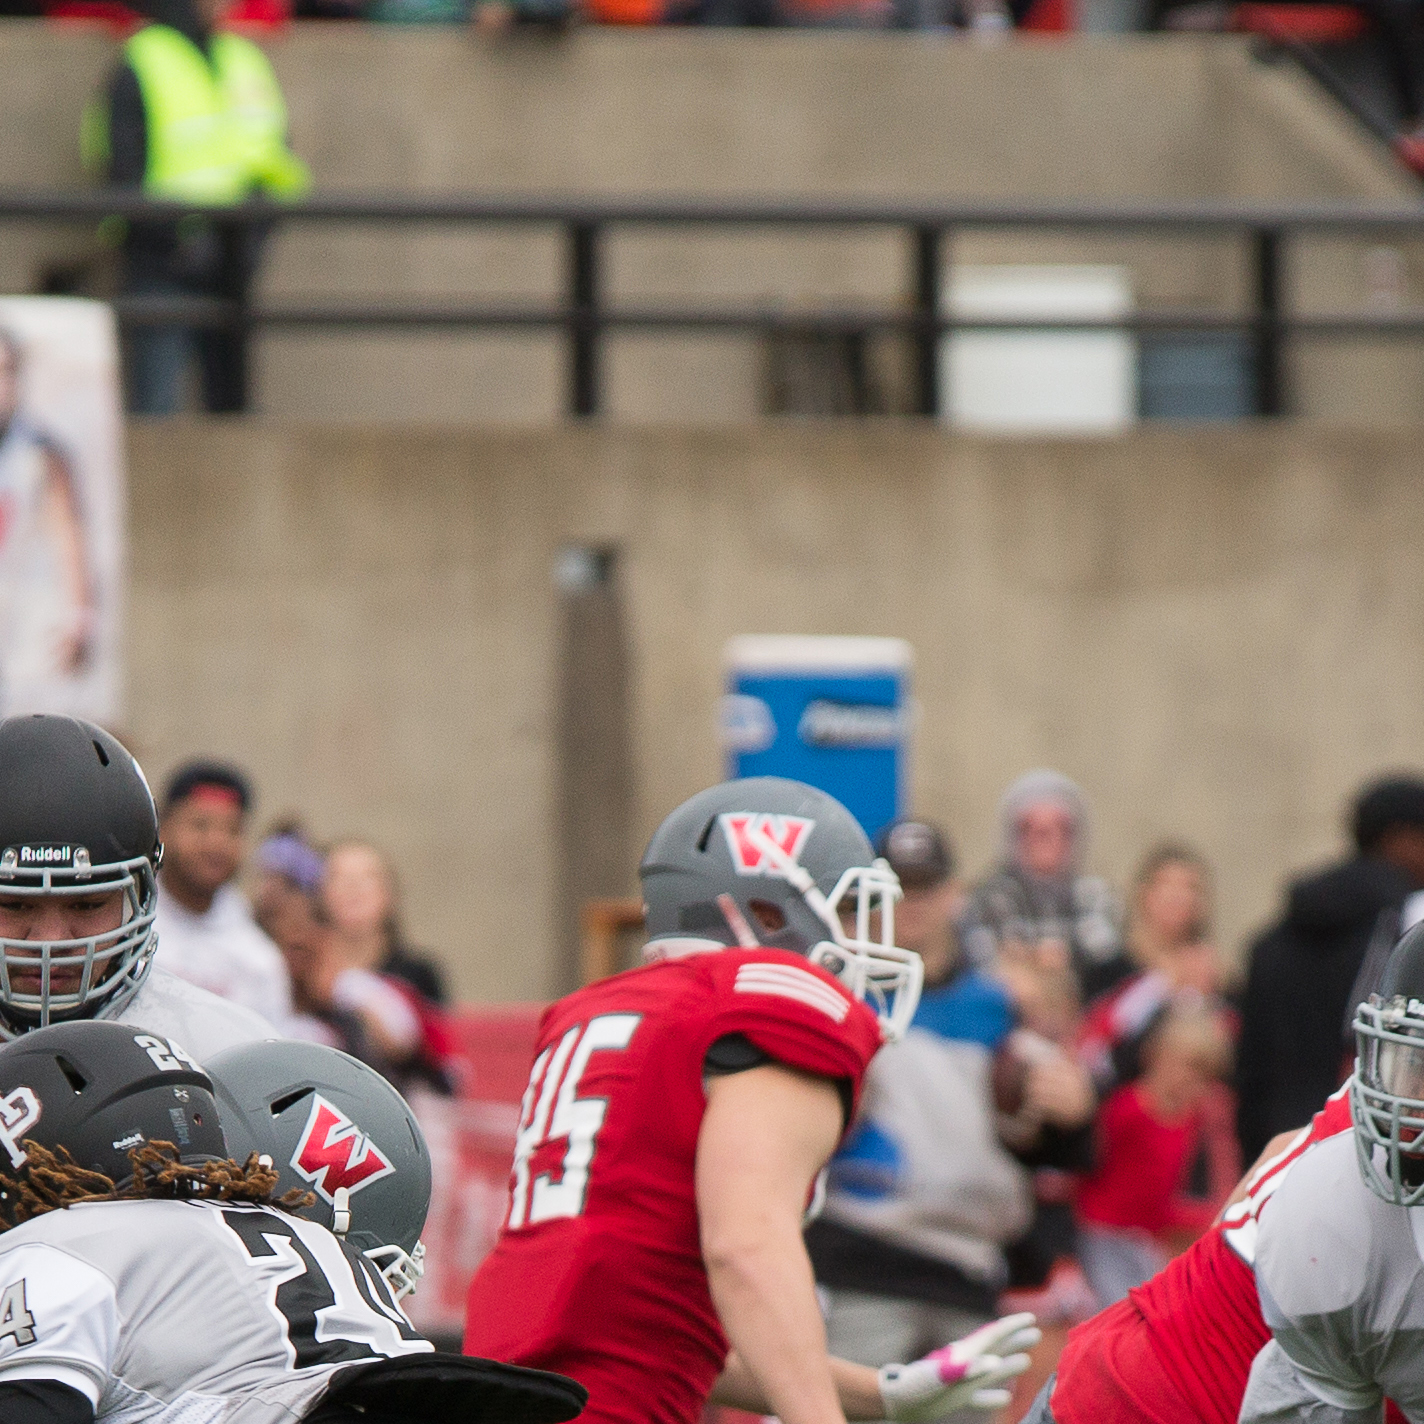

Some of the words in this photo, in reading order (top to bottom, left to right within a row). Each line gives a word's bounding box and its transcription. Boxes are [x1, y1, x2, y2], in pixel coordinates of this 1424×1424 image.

[21, 847, 70, 861] Riddell
[133, 1034, 206, 1074] 24
[289, 1093, 396, 1206] W
